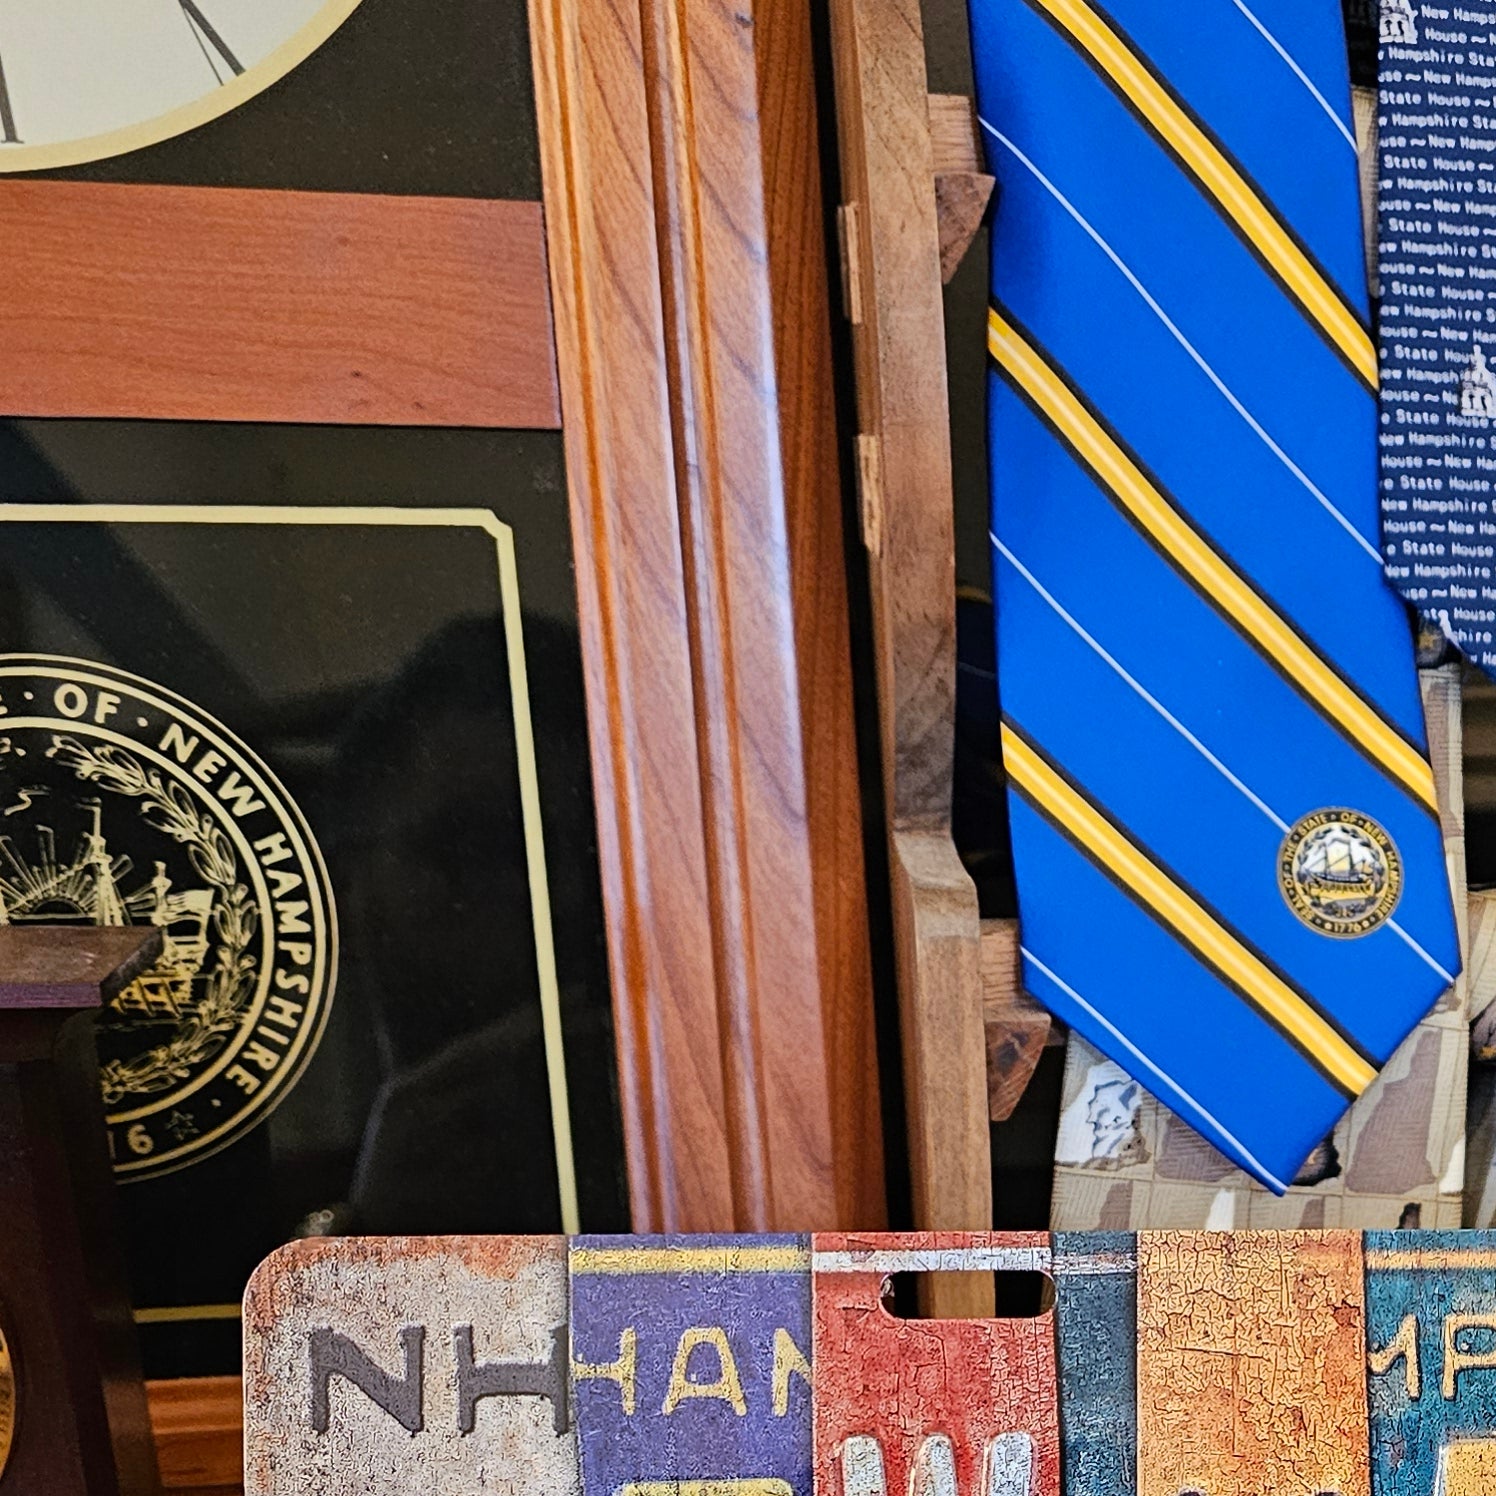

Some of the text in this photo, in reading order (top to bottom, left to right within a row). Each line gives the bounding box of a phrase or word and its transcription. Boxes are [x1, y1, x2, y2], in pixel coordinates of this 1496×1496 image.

[1421, 4, 1449, 19] New
[1425, 28, 1467, 44] House
[1389, 47, 1464, 65] Hampshire
[1424, 70, 1451, 84] New
[1428, 92, 1470, 107] House
[1392, 113, 1468, 128] Hampshire
[1384, 154, 1427, 170] State
[1433, 157, 1474, 172] House
[1398, 177, 1473, 193] Hampshire
[1389, 217, 1431, 233] State
[1438, 221, 1479, 237] House
[1392, 281, 1435, 297] State
[1442, 286, 1484, 301] House
[1409, 432, 1485, 449] Hampshire
[1403, 539, 1444, 556] State
[1452, 542, 1493, 558] House
[1415, 564, 1490, 579] Hampshire
[1299, 813, 1329, 837] STATE
[1340, 812, 1358, 824] OF
[1363, 821, 1389, 847] NEW
[1378, 850, 1401, 918] HAMPSHIRE
[53, 682, 313, 1096] OF NEW HAMPSHIRE
[1333, 920, 1363, 934] 1776
